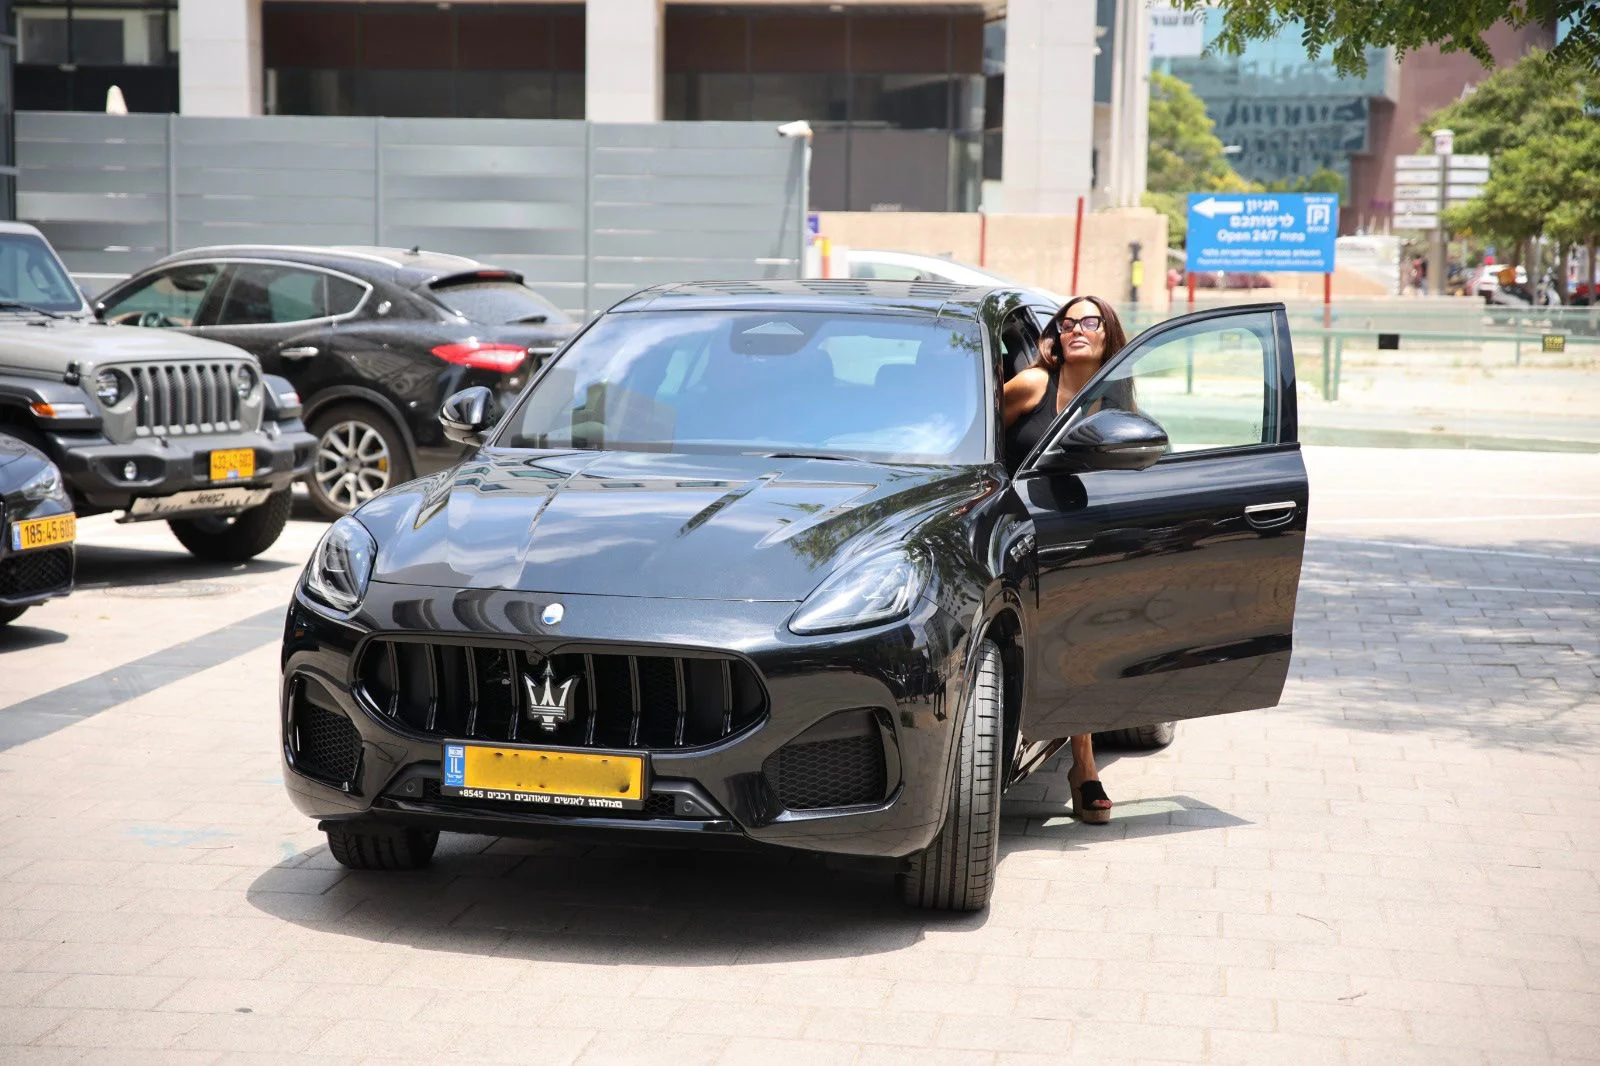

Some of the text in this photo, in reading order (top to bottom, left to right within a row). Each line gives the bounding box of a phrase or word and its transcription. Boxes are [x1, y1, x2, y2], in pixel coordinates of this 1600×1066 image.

[1216, 228, 1251, 243] Open
[1251, 229, 1279, 242] 24/7
[189, 492, 225, 505] Jeep
[450, 757, 461, 774] IL
[487, 791, 511, 801] רכבים
[514, 793, 551, 803] שאוהבים
[554, 796, 585, 806] לאנשים
